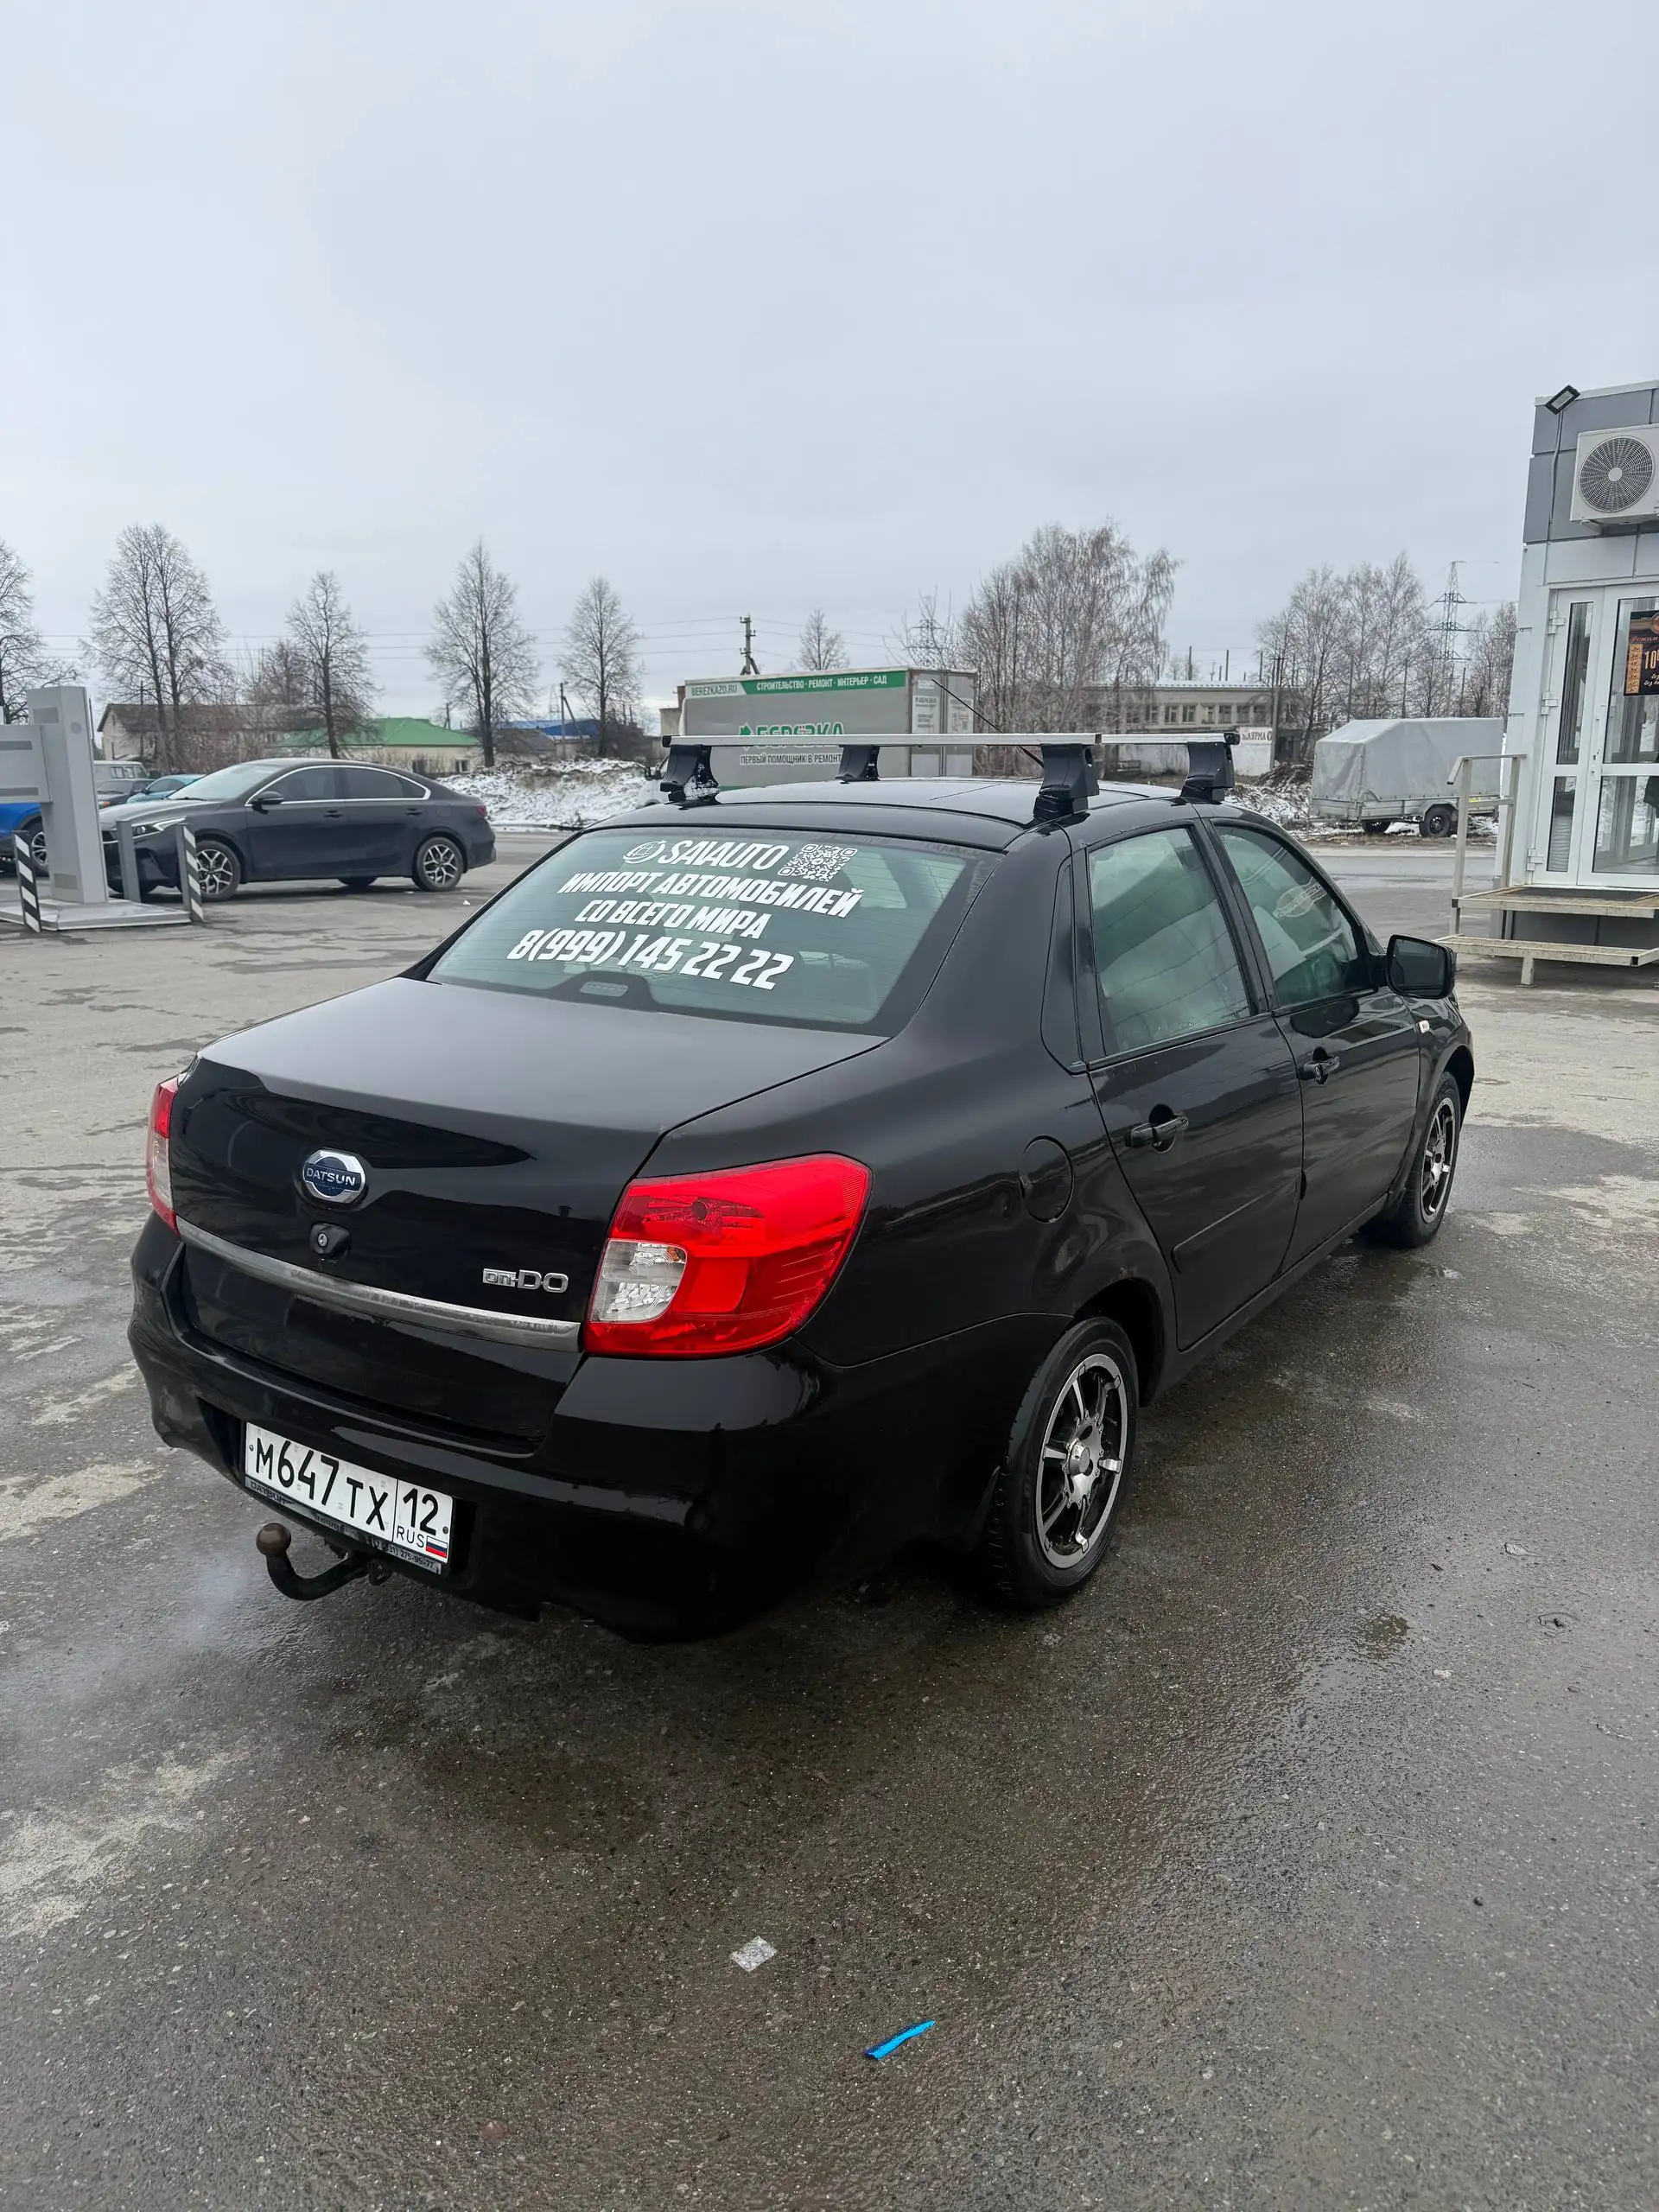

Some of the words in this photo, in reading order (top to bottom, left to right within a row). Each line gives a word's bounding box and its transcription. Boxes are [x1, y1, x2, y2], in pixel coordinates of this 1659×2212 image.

[756, 680, 804, 691] СТРОИТЕЛЬСТВО
[808, 678, 833, 688] РЕМОНТ
[837, 677, 868, 687] ИНТЕРЬЕР
[874, 675, 887, 684] САД
[741, 753, 766, 764] ПЕРВЫЙ
[767, 753, 806, 765] ПОМОЩНИК
[808, 753, 813, 763] В
[814, 753, 842, 763] РЕМОНТ
[557, 871, 664, 893] ИМПОРТ
[650, 873, 864, 918] АВТОМОБИЛЕЙ
[574, 899, 617, 923] СО
[606, 900, 695, 928] ВСЕГО
[684, 906, 772, 939] МИРА
[506, 928, 626, 965] 8(999)
[617, 934, 692, 971] 145
[679, 941, 742, 980] 22
[729, 949, 794, 990] 22
[306, 1167, 356, 1186] DATSUN
[403, 1488, 440, 1536] 12
[396, 1525, 425, 1548] RUS
